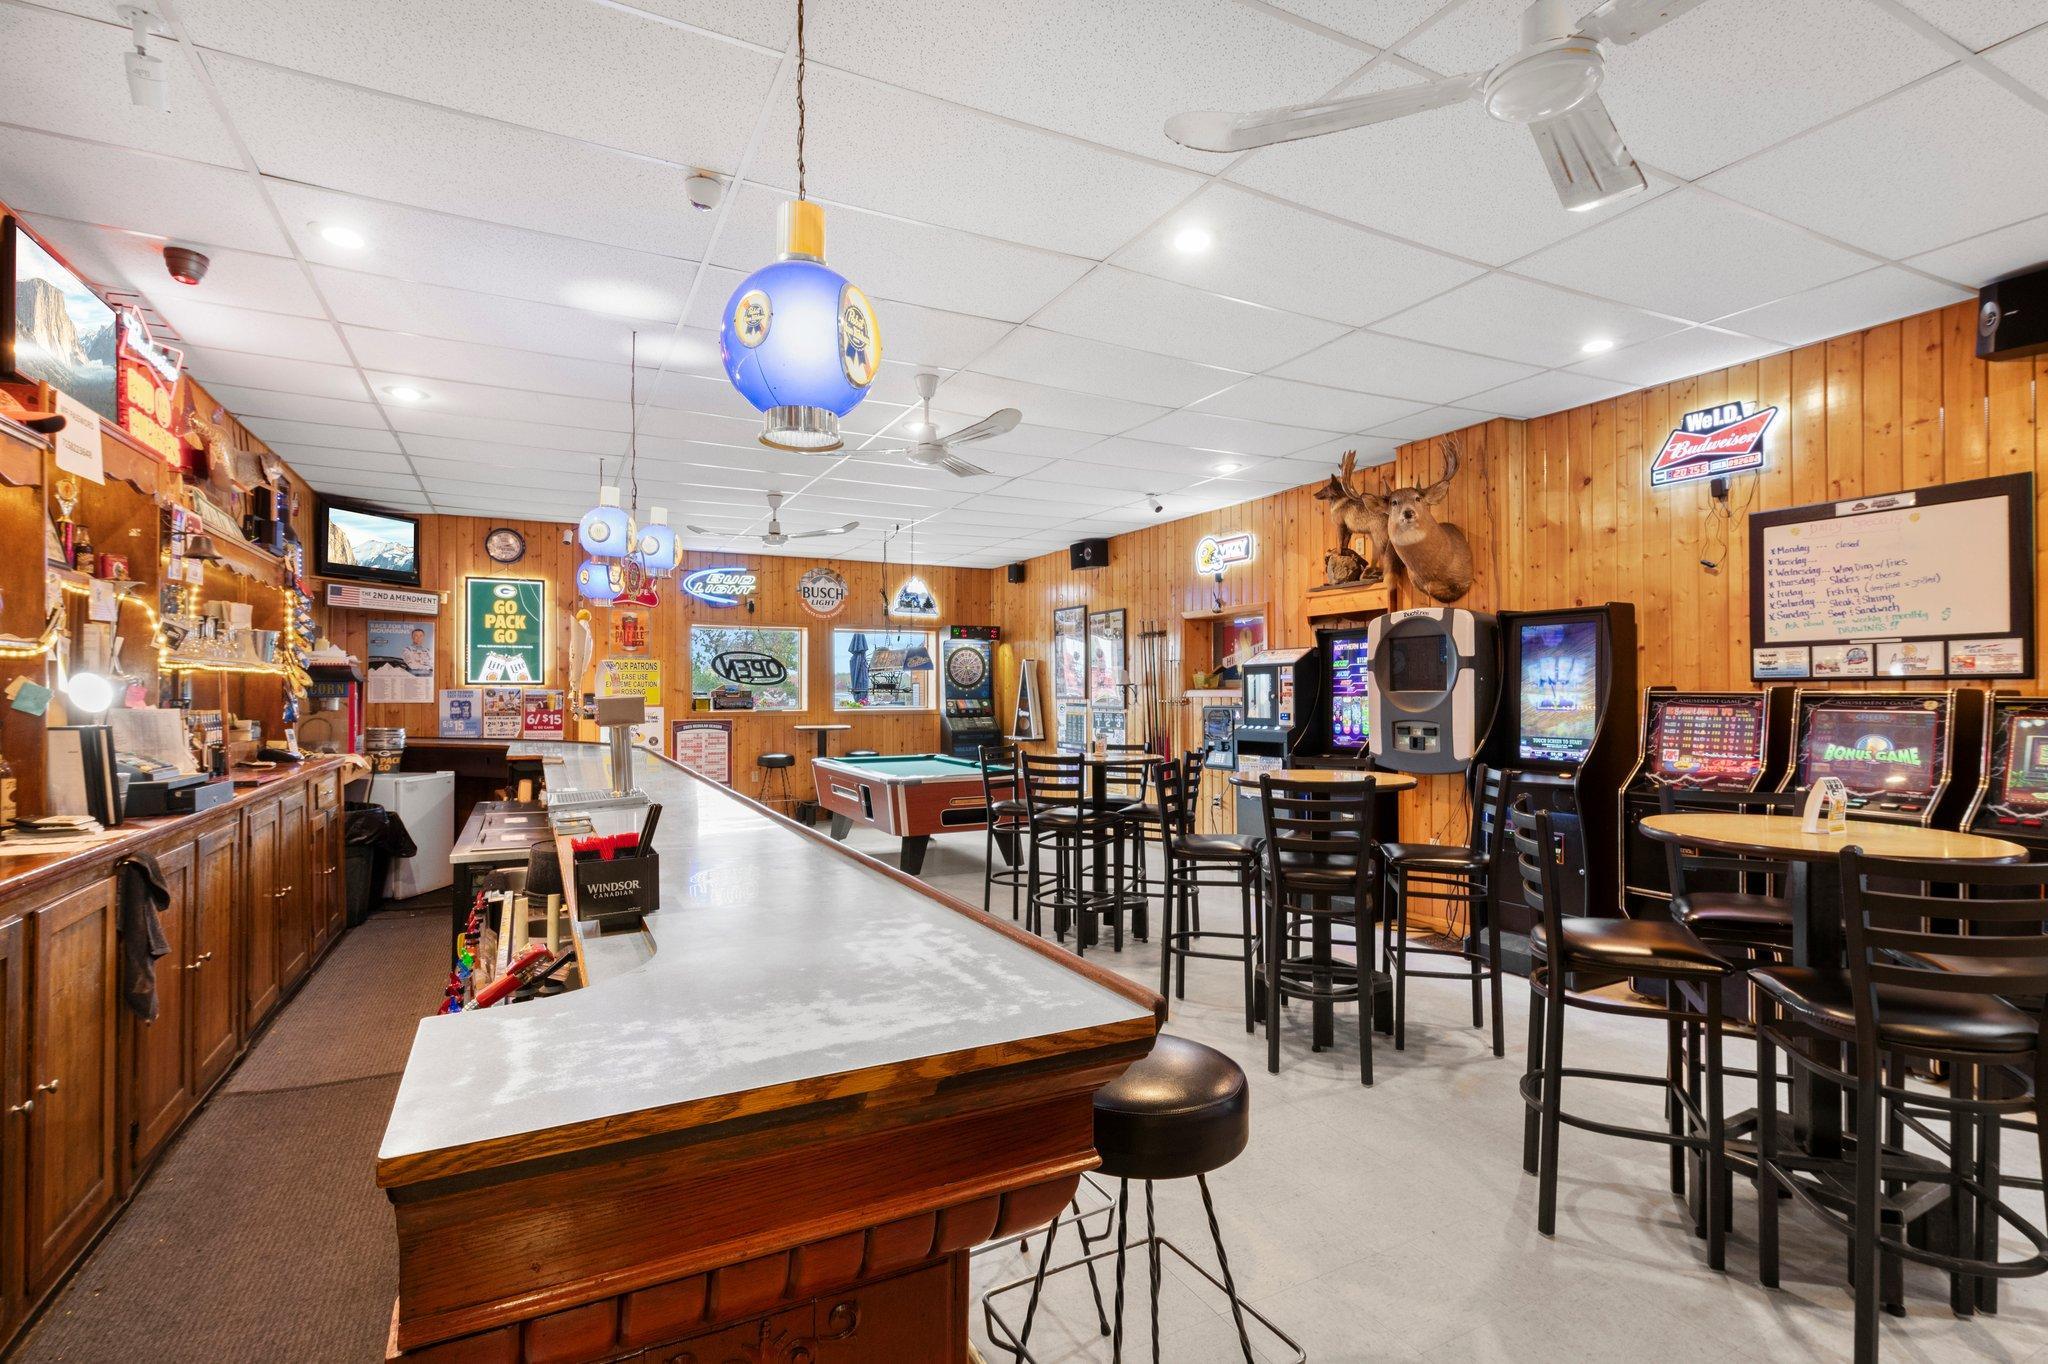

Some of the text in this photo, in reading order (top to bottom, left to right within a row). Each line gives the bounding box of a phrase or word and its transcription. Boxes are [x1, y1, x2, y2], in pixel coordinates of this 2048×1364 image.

[1667, 431, 1759, 460] Budweiser
[1777, 540, 1860, 555] Monday closed
[706, 573, 756, 585] BUD
[692, 582, 756, 596] LIGHT
[802, 586, 844, 600] BUSCH
[373, 591, 389, 600] 2ND
[390, 594, 437, 605] AMENDMENT
[1776, 599, 1816, 610] Saturday
[493, 600, 518, 615] GO
[1777, 609, 1811, 620] Sunday
[1855, 604, 1900, 615] Sandwich
[484, 614, 527, 629] PACK
[493, 629, 518, 643] GO
[487, 660, 504, 671] Lite
[510, 662, 526, 674] Lite
[630, 662, 657, 671] PATRONS
[527, 714, 562, 725] 6/ $15
[1823, 743, 1922, 767] BONUS GAME
[378, 764, 391, 772] GO
[587, 879, 640, 895] WINDSOR
[593, 889, 634, 900] CANADIAN
